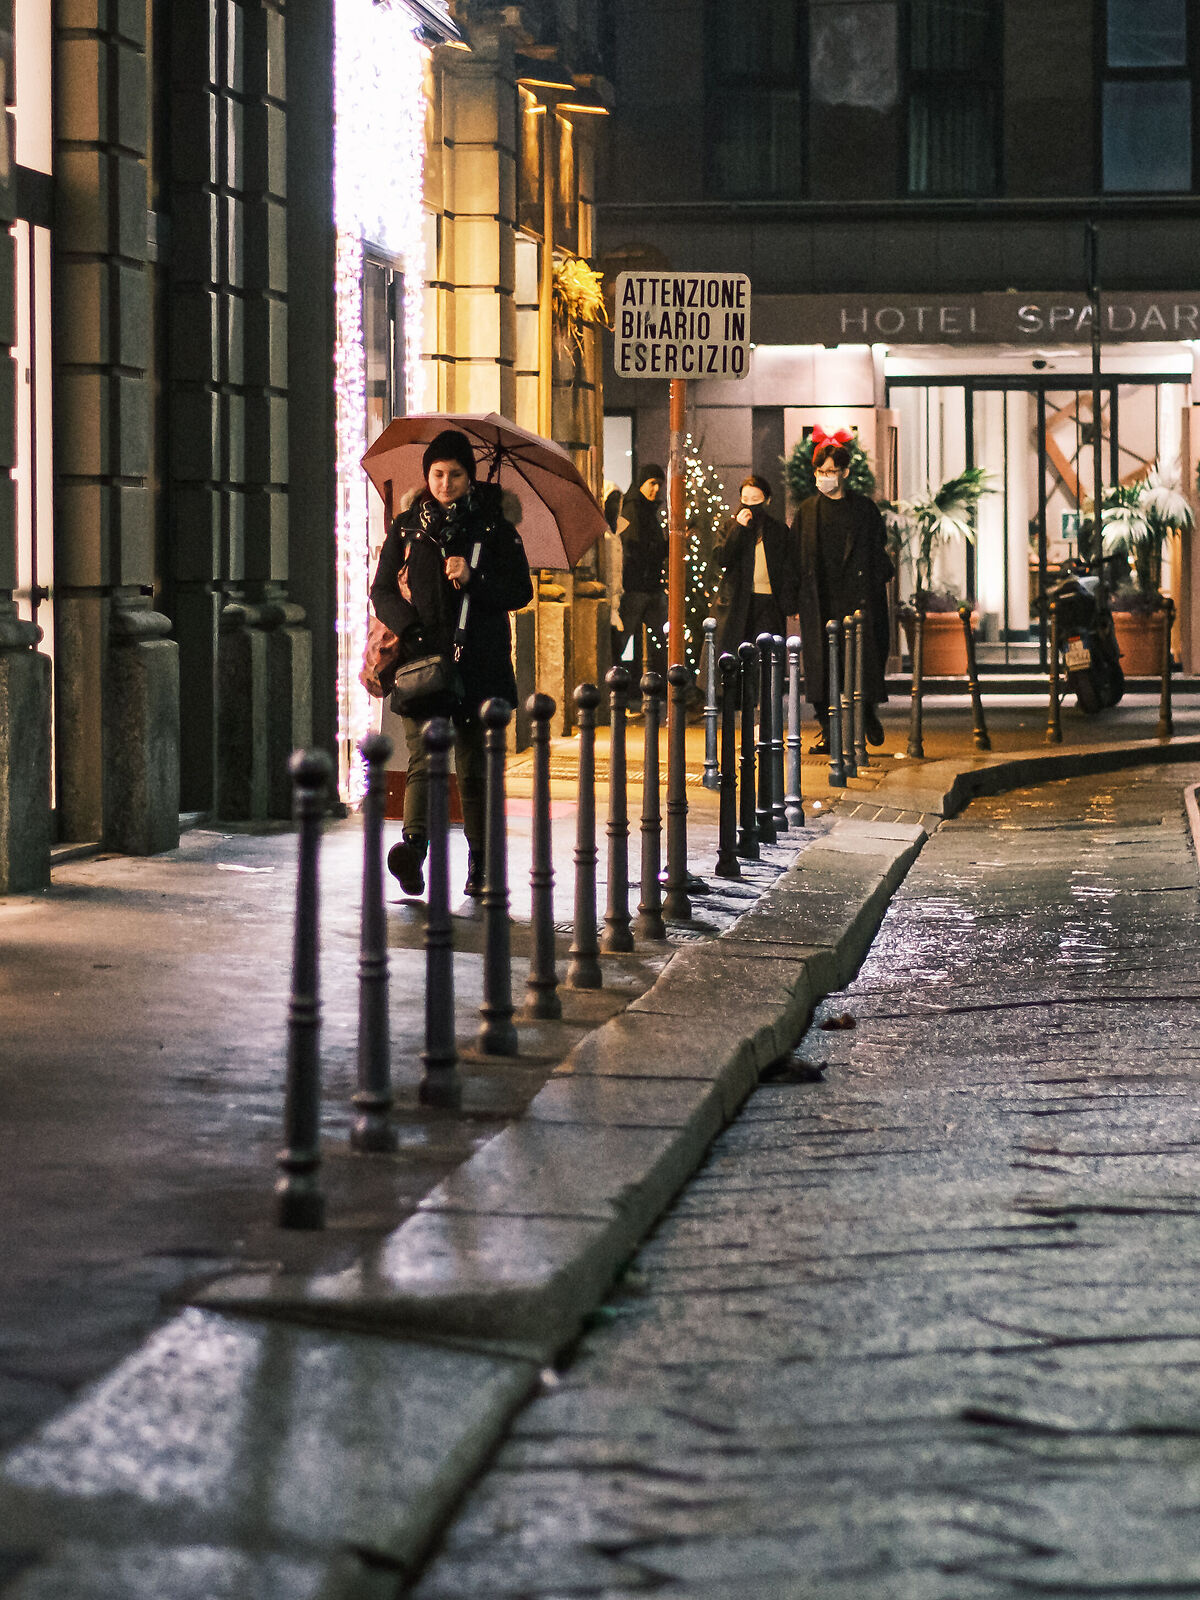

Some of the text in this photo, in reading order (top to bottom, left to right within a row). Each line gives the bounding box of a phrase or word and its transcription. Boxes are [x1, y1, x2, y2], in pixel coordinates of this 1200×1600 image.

[622, 278, 746, 308] ATTENZIONE
[621, 310, 745, 341] BINARIO IN
[840, 306, 990, 334] HOTEL
[620, 343, 744, 374] ESERCIZIO
